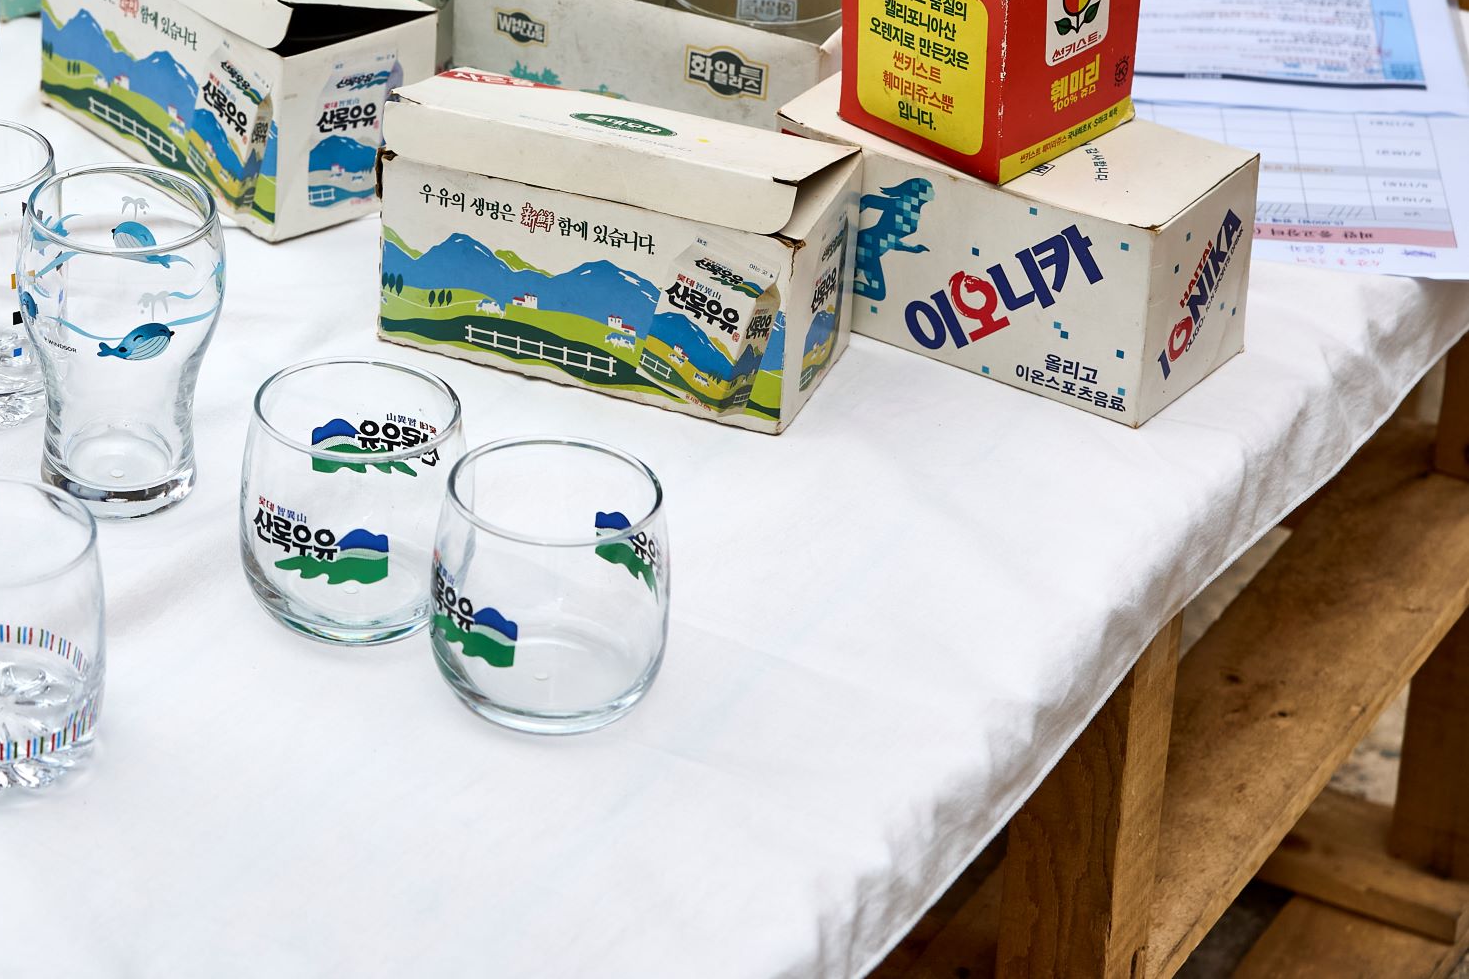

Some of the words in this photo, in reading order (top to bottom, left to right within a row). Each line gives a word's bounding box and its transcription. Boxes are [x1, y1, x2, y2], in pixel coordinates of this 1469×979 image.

[497, 13, 545, 34] WHITE
[869, 16, 916, 52] 오렌지로
[918, 35, 970, 71] 만든것은
[1051, 31, 1098, 62] 썬키스트
[892, 49, 942, 85] 썬키스트
[1050, 53, 1101, 102] 훼미리
[202, 80, 247, 136] 산록우유
[882, 70, 955, 115] 훼미리쥬스뿐
[897, 99, 937, 131] 입니다.
[1053, 93, 1078, 113] 100%
[316, 103, 377, 133] 산록우유
[419, 184, 465, 212] 우유의
[470, 196, 516, 223] 생명은
[520, 202, 555, 233] 新鮮
[558, 216, 588, 241] 함에
[593, 225, 656, 255] 있습니다.
[904, 224, 1104, 351] 이오니카
[1157, 208, 1242, 381] IONIKA
[1180, 239, 1213, 309] HAITAI
[1215, 258, 1231, 294] SPORTS
[665, 281, 740, 334] 산록우유
[48, 339, 77, 354] WINDSOR
[1044, 353, 1099, 386] 올리고
[1015, 364, 1127, 413] 이온스포츠음료
[254, 507, 338, 561] 산록우유
